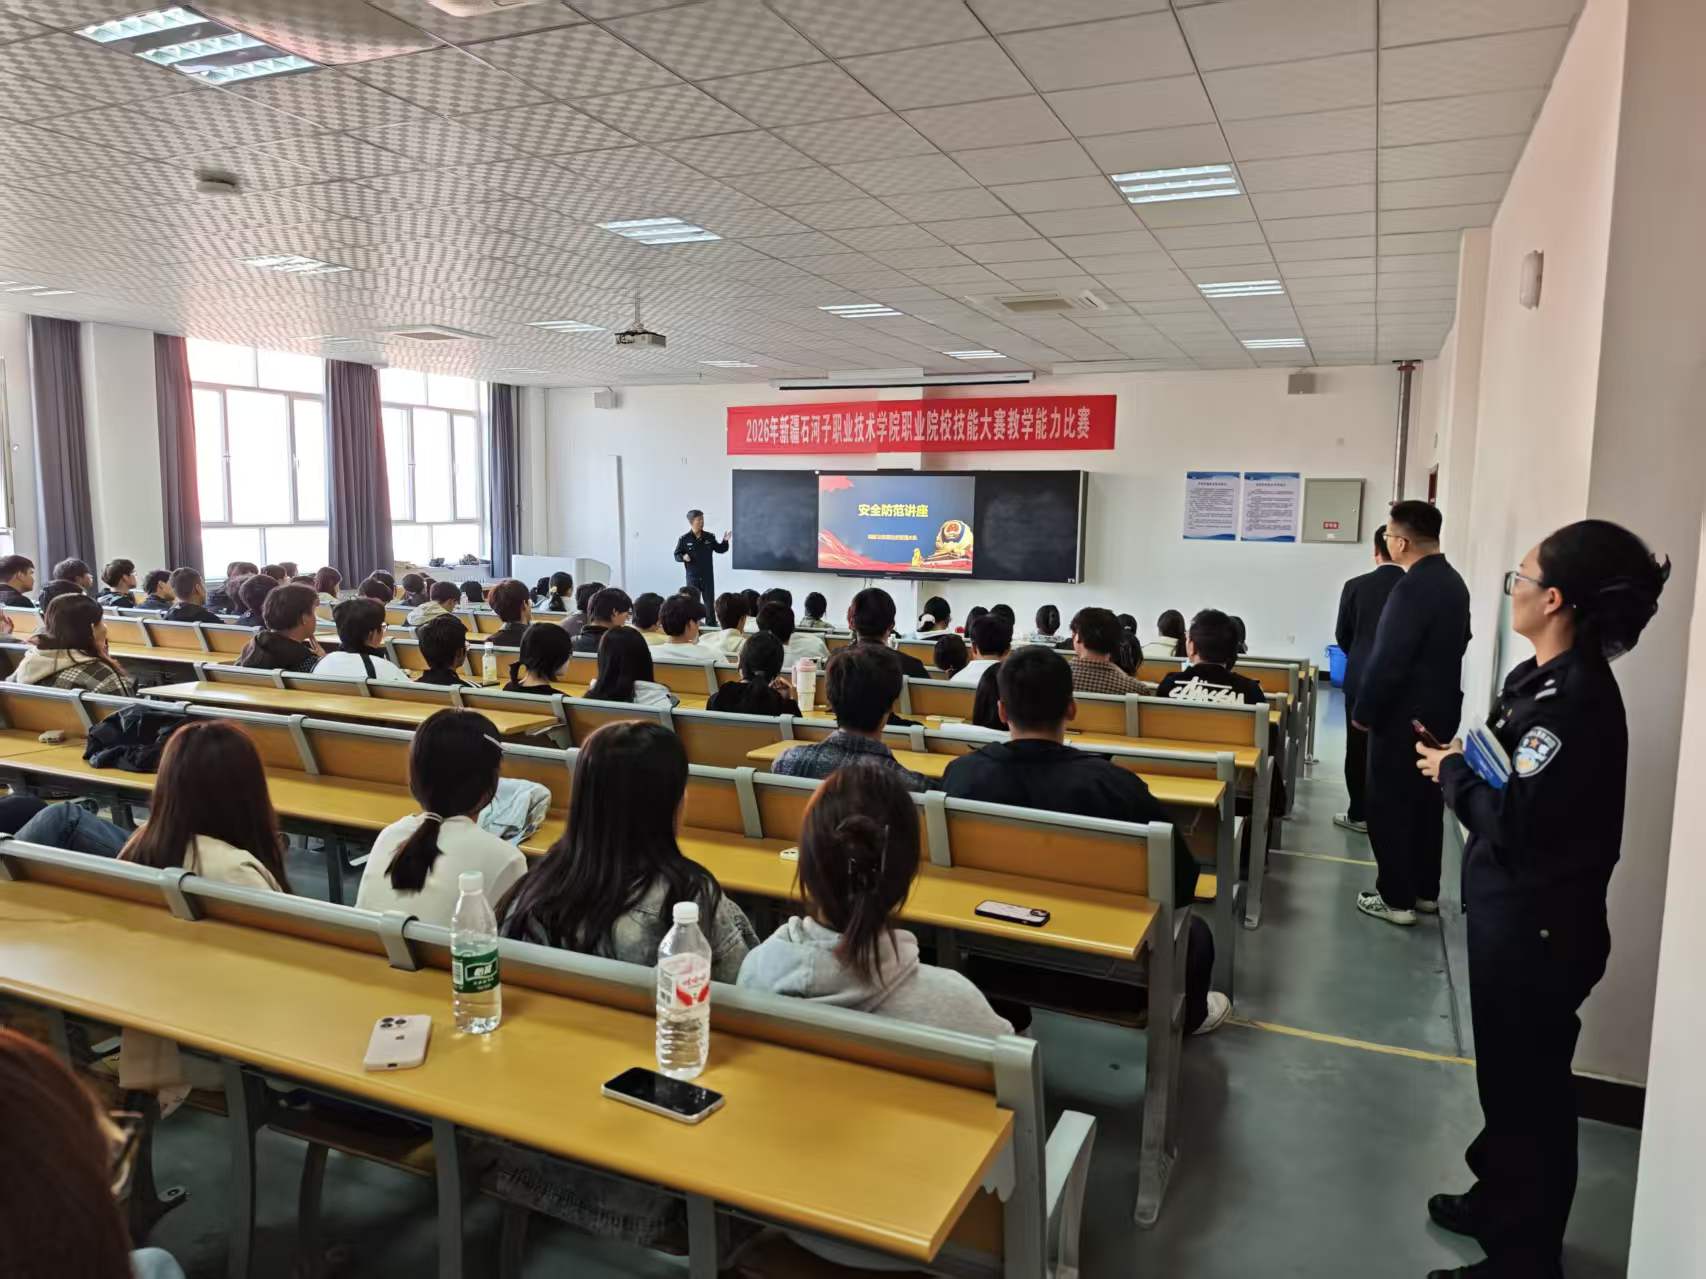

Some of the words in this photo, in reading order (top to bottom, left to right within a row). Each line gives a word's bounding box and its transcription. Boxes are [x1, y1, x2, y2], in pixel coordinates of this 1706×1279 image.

[746, 406, 1091, 445] 2026年新疆石河子职业技术学院职业院校技能大赛教学能力比赛
[858, 503, 929, 518] 安全防范讲座
